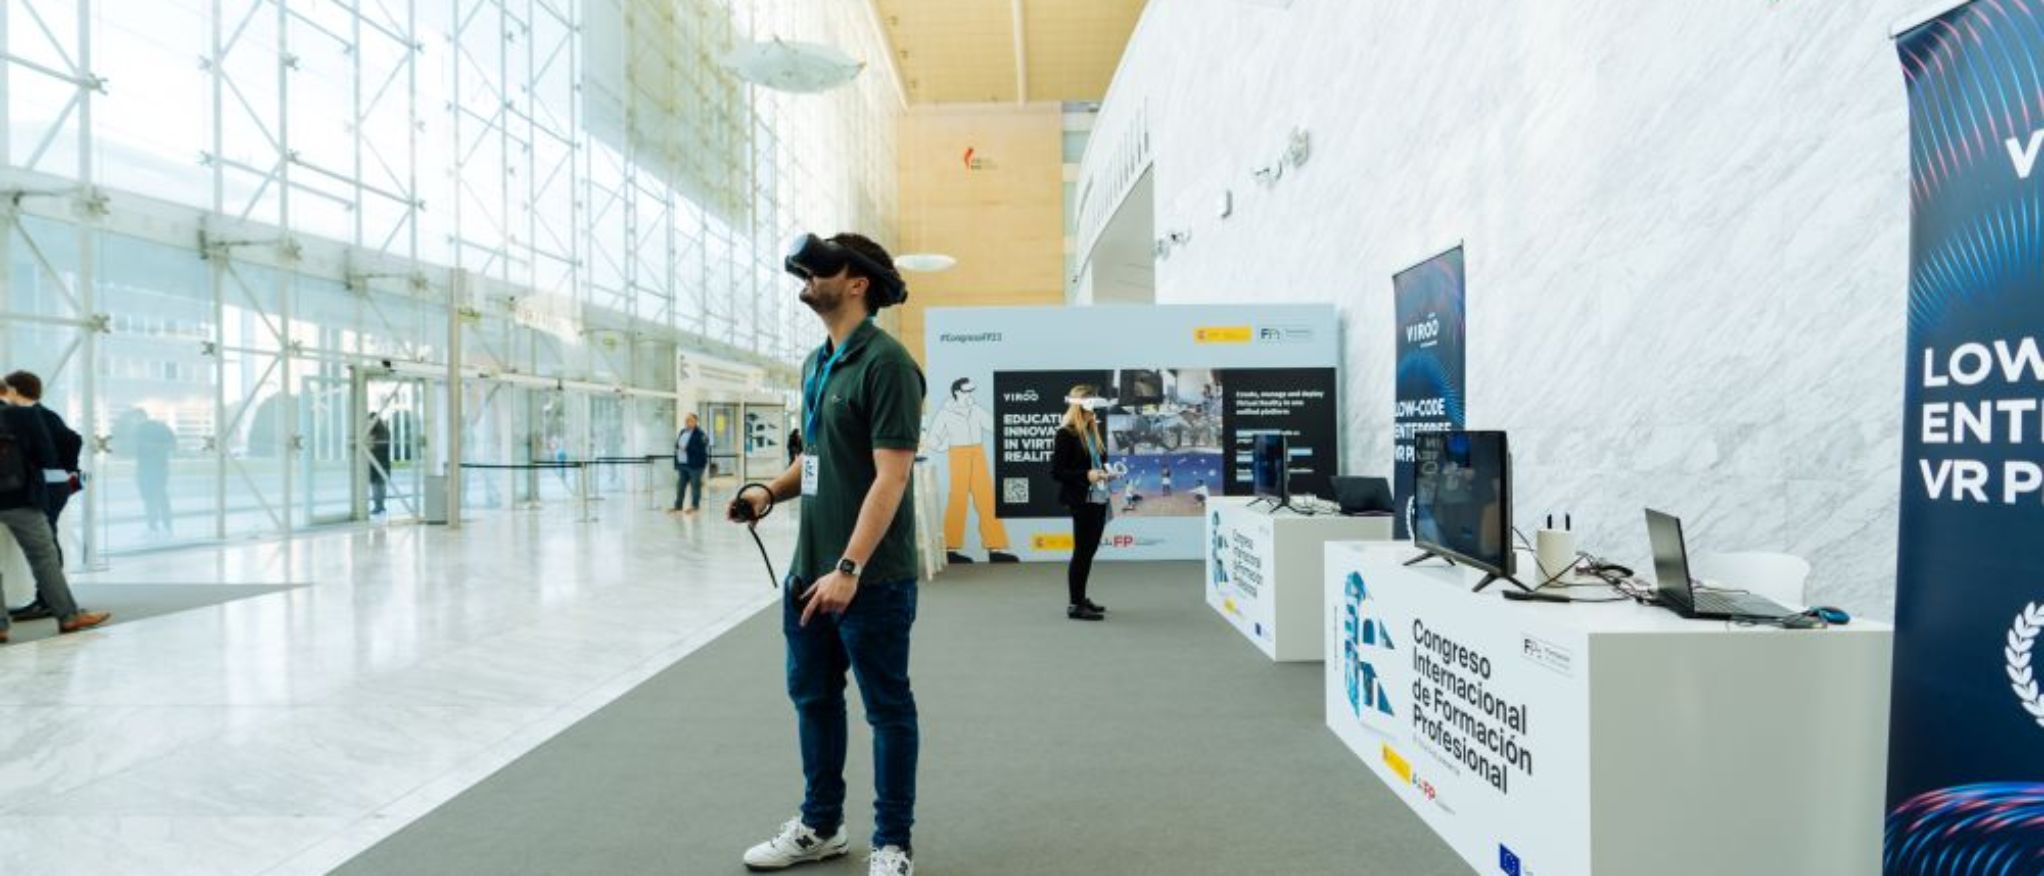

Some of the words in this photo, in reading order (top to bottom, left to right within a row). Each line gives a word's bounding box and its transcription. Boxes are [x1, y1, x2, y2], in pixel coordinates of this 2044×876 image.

[1406, 319, 1439, 343] VIROO
[1003, 393, 1039, 402] VIROO
[1004, 414, 1062, 424] EDUCATI
[1004, 426, 1057, 437] INNOVA
[1922, 399, 2044, 443] ENT
[1004, 438, 1018, 450] IN
[1021, 438, 1056, 450] VIRT
[1004, 451, 1054, 462] REALIT
[1919, 459, 1989, 503] VR
[1413, 618, 1491, 680] Congreso
[1413, 645, 1526, 736] Internacional
[1412, 677, 1430, 707] de
[1434, 687, 1532, 776] Formación
[1413, 703, 1507, 795] Profesional
